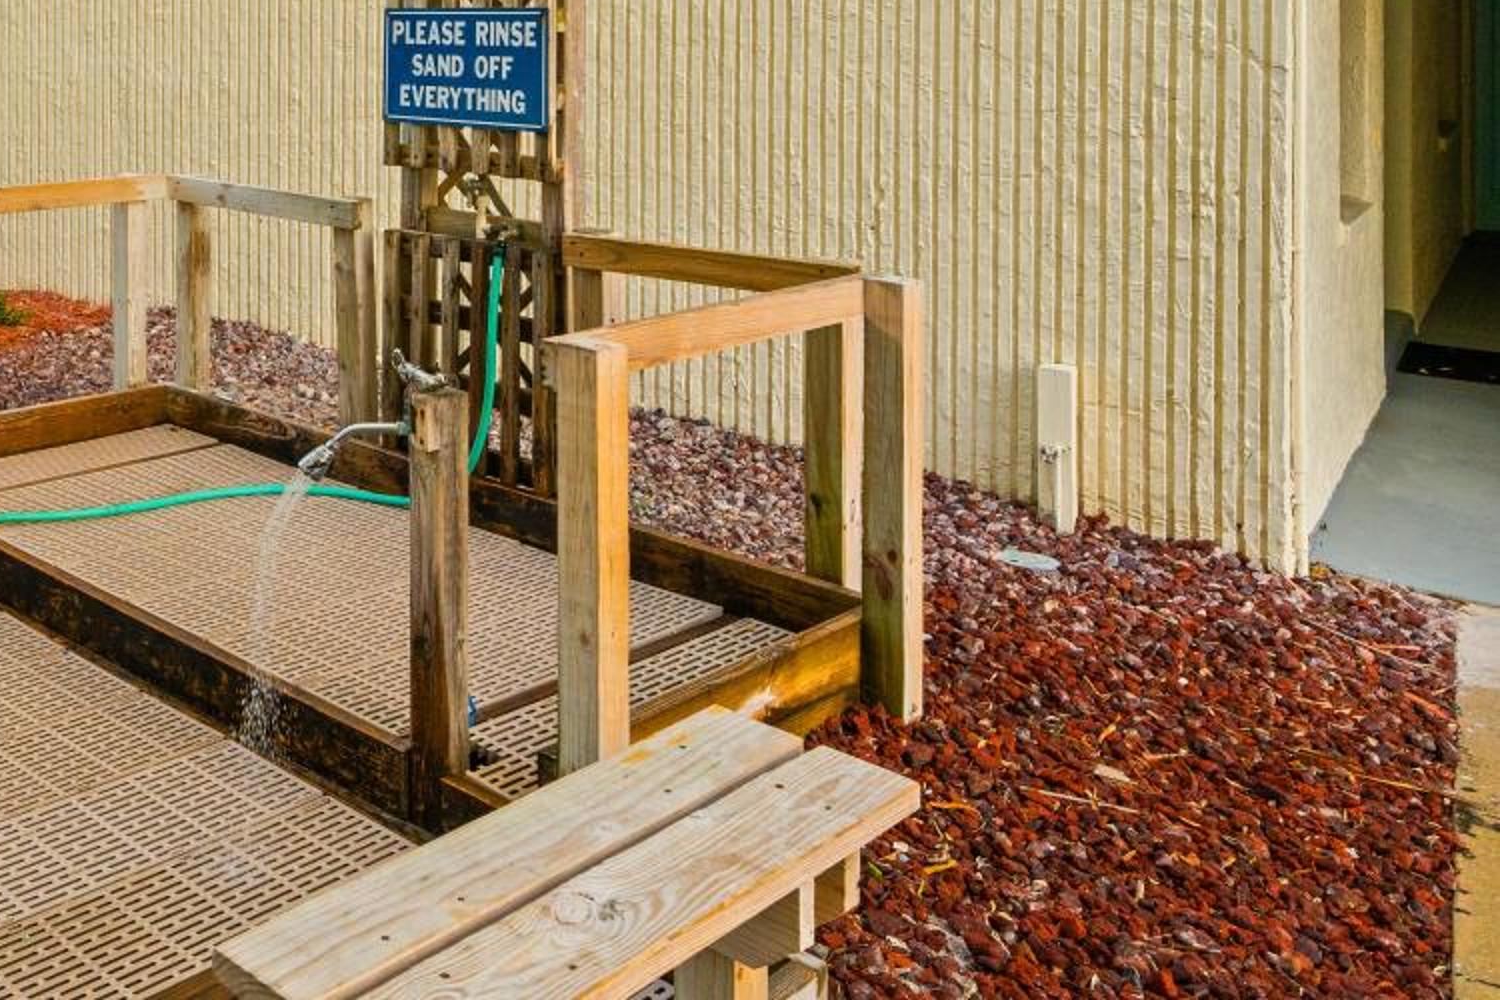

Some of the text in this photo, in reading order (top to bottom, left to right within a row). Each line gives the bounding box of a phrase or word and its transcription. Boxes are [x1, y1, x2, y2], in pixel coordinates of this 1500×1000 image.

[392, 20, 537, 47] PLEASE RINSE
[411, 54, 514, 80] SAND OFF
[399, 84, 526, 114] EVERYTHING
